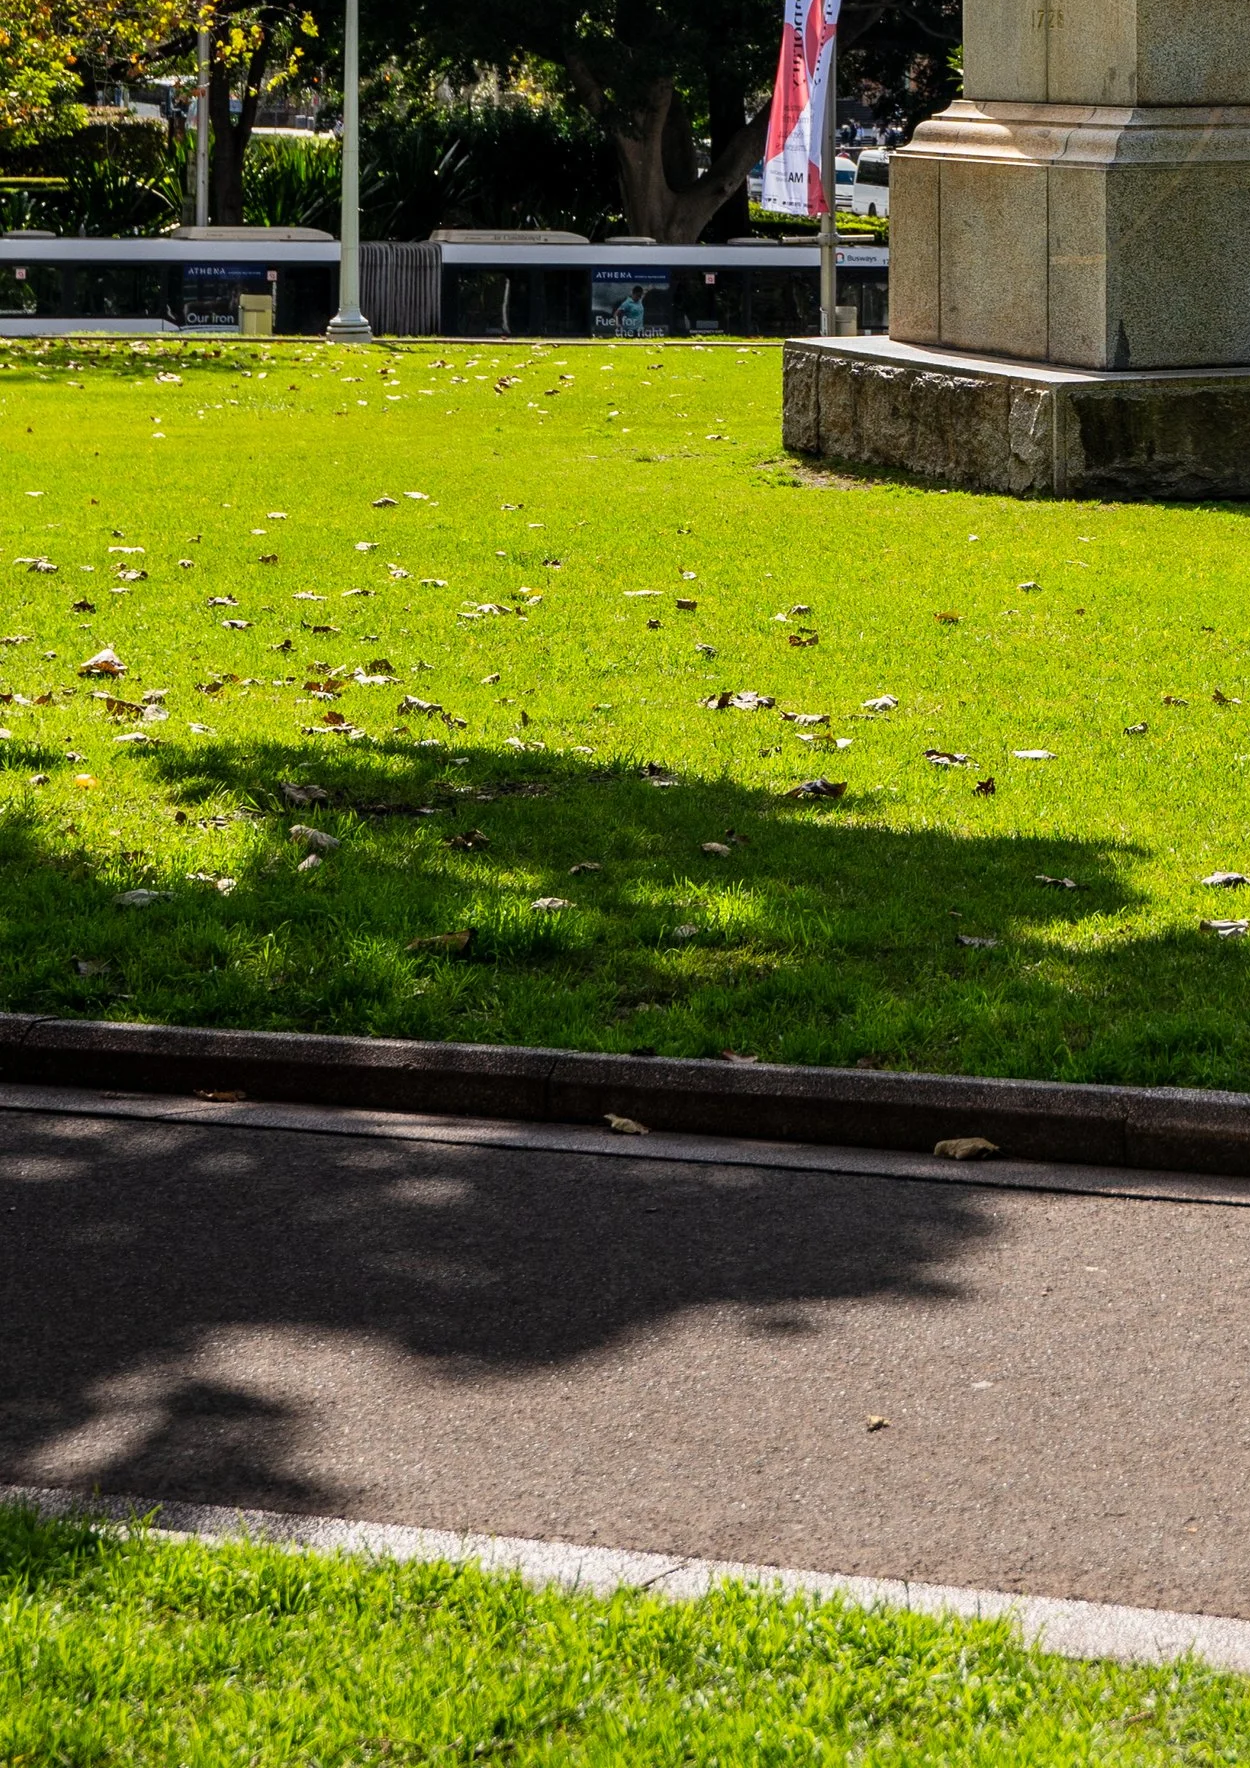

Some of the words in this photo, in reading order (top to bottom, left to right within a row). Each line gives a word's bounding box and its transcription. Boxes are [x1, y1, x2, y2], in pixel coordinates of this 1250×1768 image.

[847, 255, 877, 263] Busways
[188, 267, 226, 275] ATHENA
[187, 313, 209, 323] Our
[212, 312, 235, 323] iron
[595, 316, 619, 326] Fuel
[622, 316, 637, 326] for
[615, 327, 634, 337] the
